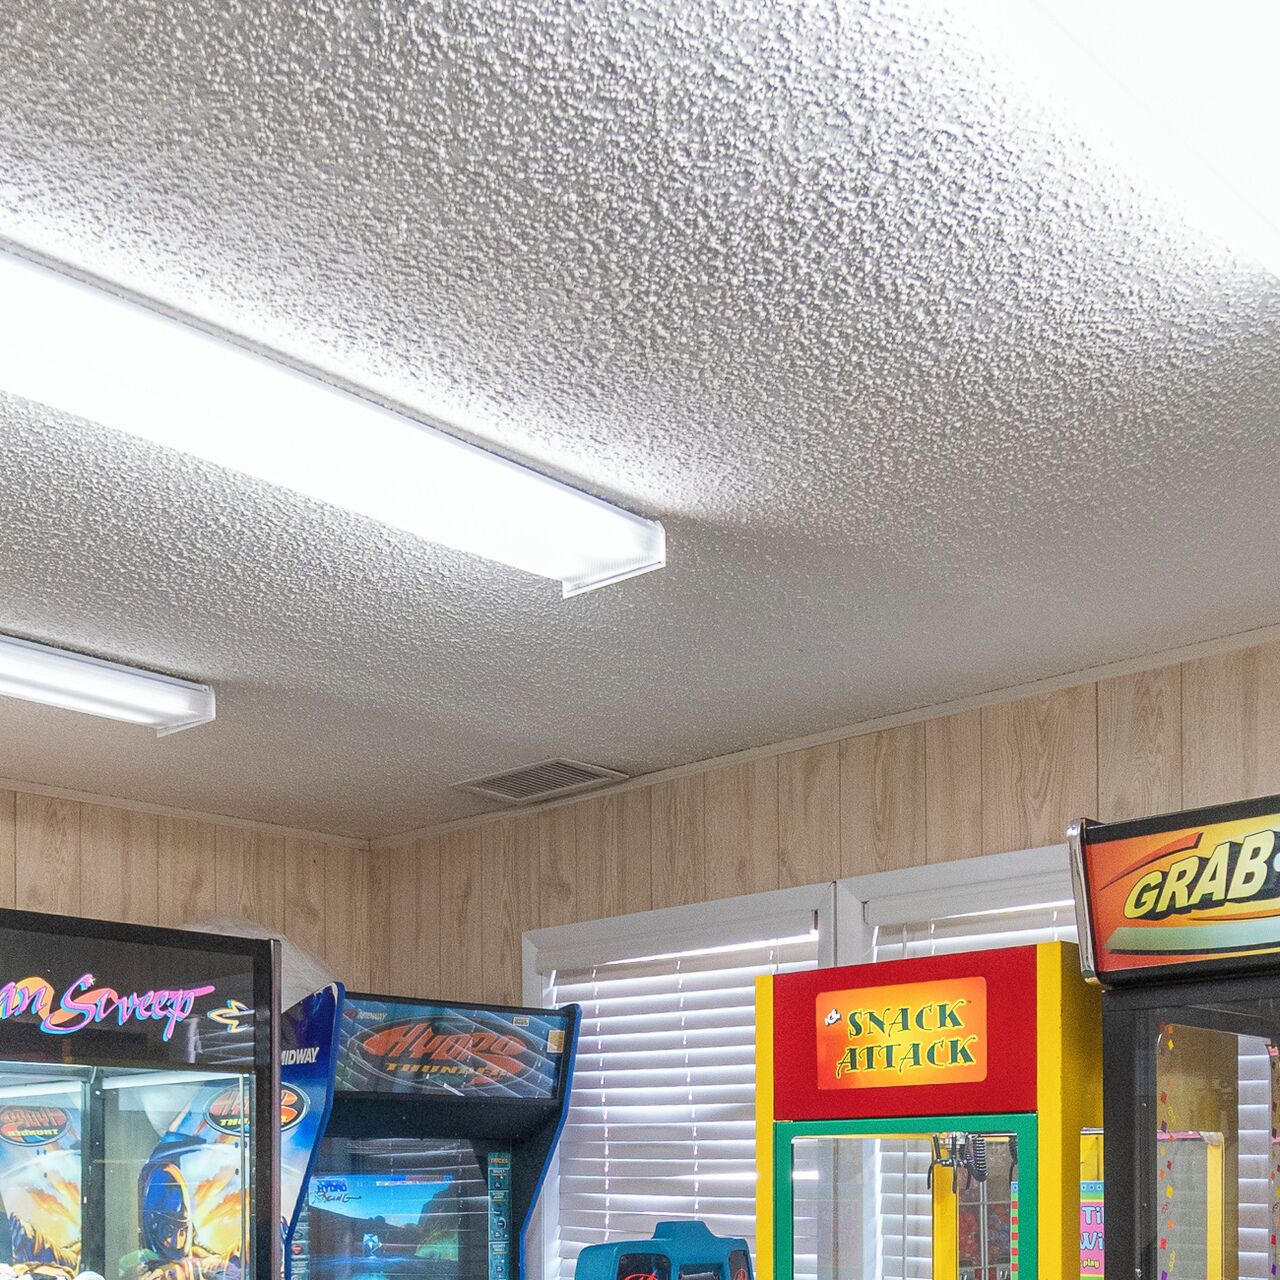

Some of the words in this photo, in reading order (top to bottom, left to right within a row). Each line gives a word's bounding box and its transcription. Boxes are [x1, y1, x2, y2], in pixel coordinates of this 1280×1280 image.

[40, 973, 215, 1042] Sweep
[848, 999, 966, 1039] SNACK
[363, 1021, 528, 1066] HYDRO
[835, 1036, 977, 1079] ATTACK
